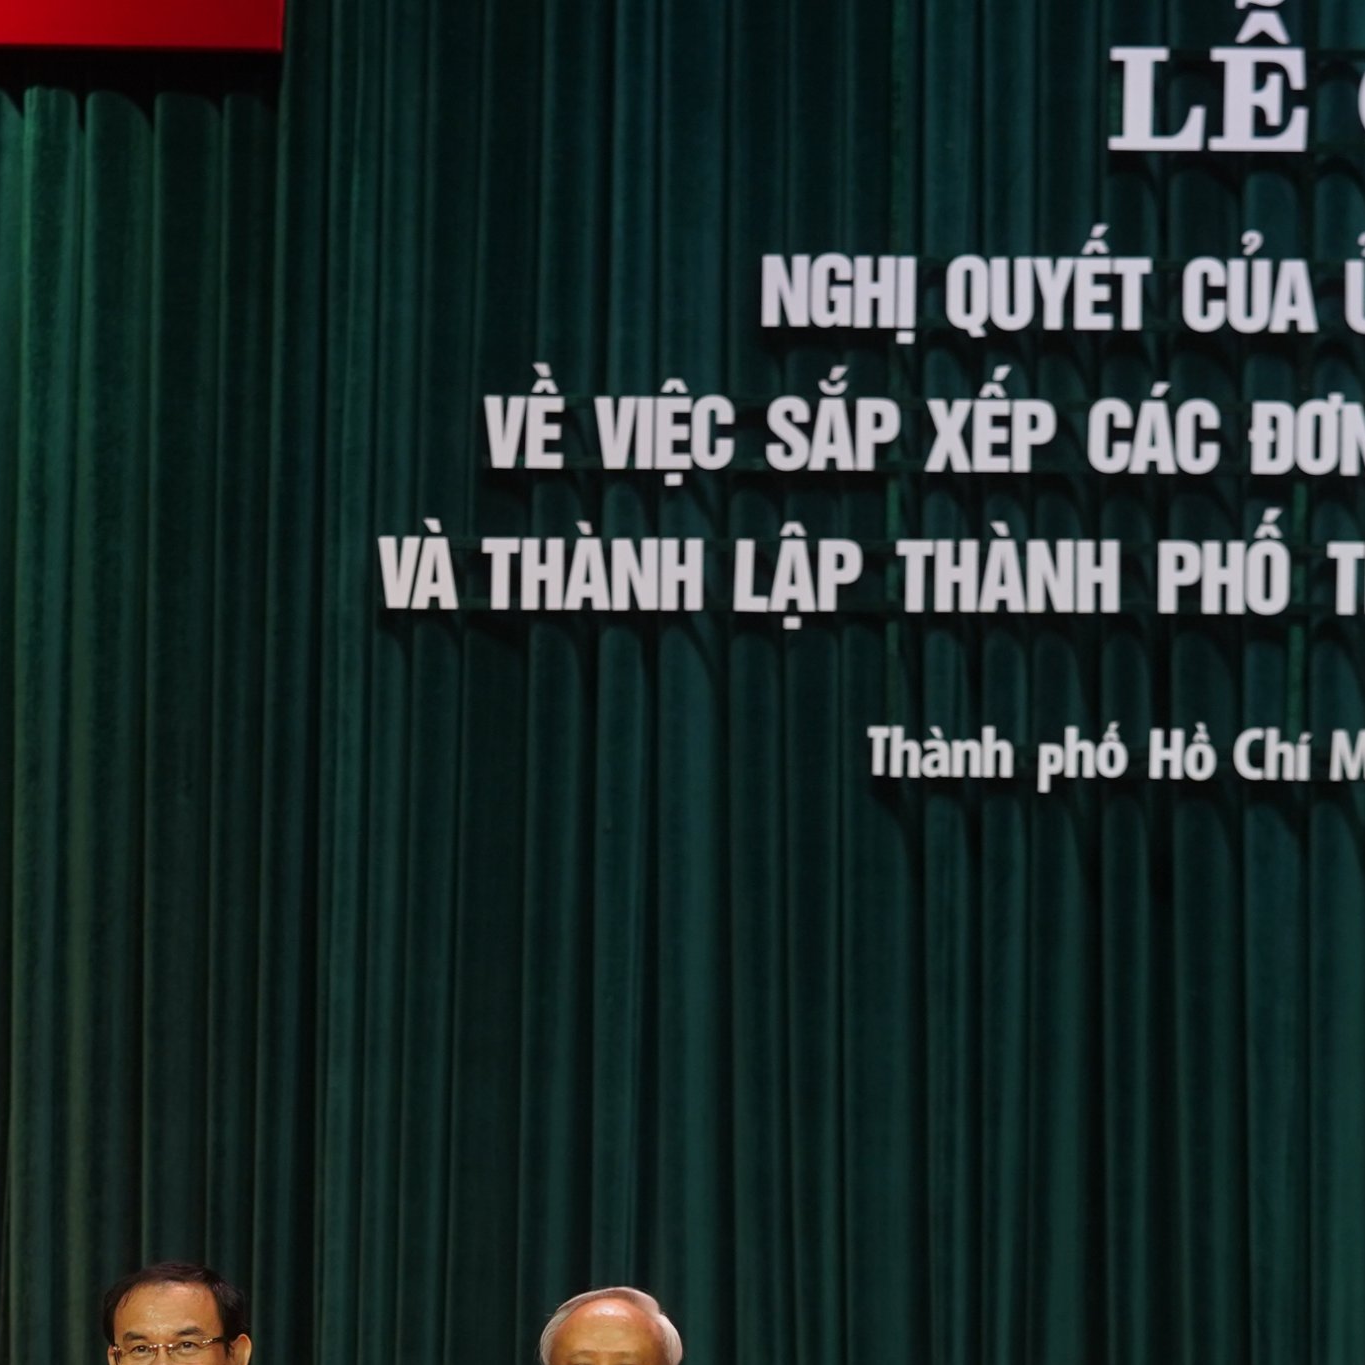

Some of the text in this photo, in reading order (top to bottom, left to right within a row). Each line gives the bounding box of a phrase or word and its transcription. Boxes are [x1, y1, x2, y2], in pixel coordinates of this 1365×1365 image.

[1109, 0, 1307, 152] LỄ
[762, 253, 916, 344] NGHỊ
[946, 224, 1152, 337] QUYẾT
[1183, 231, 1317, 333] CỦA
[485, 363, 564, 469] VỀ
[595, 379, 734, 486] VIỆC
[766, 366, 900, 471] SẮP
[925, 366, 1056, 472] XẾP
[1088, 382, 1219, 474] CÁC
[378, 518, 458, 609] VÀ
[482, 521, 703, 611] THÀNH
[734, 522, 862, 629] LẬP
[896, 522, 1119, 613] THÀNH
[1158, 508, 1289, 615] PHỐ
[868, 726, 1013, 778] Thành
[1038, 722, 1127, 793] phố
[1149, 723, 1216, 780] Hồ
[1234, 728, 1310, 781] Chí
